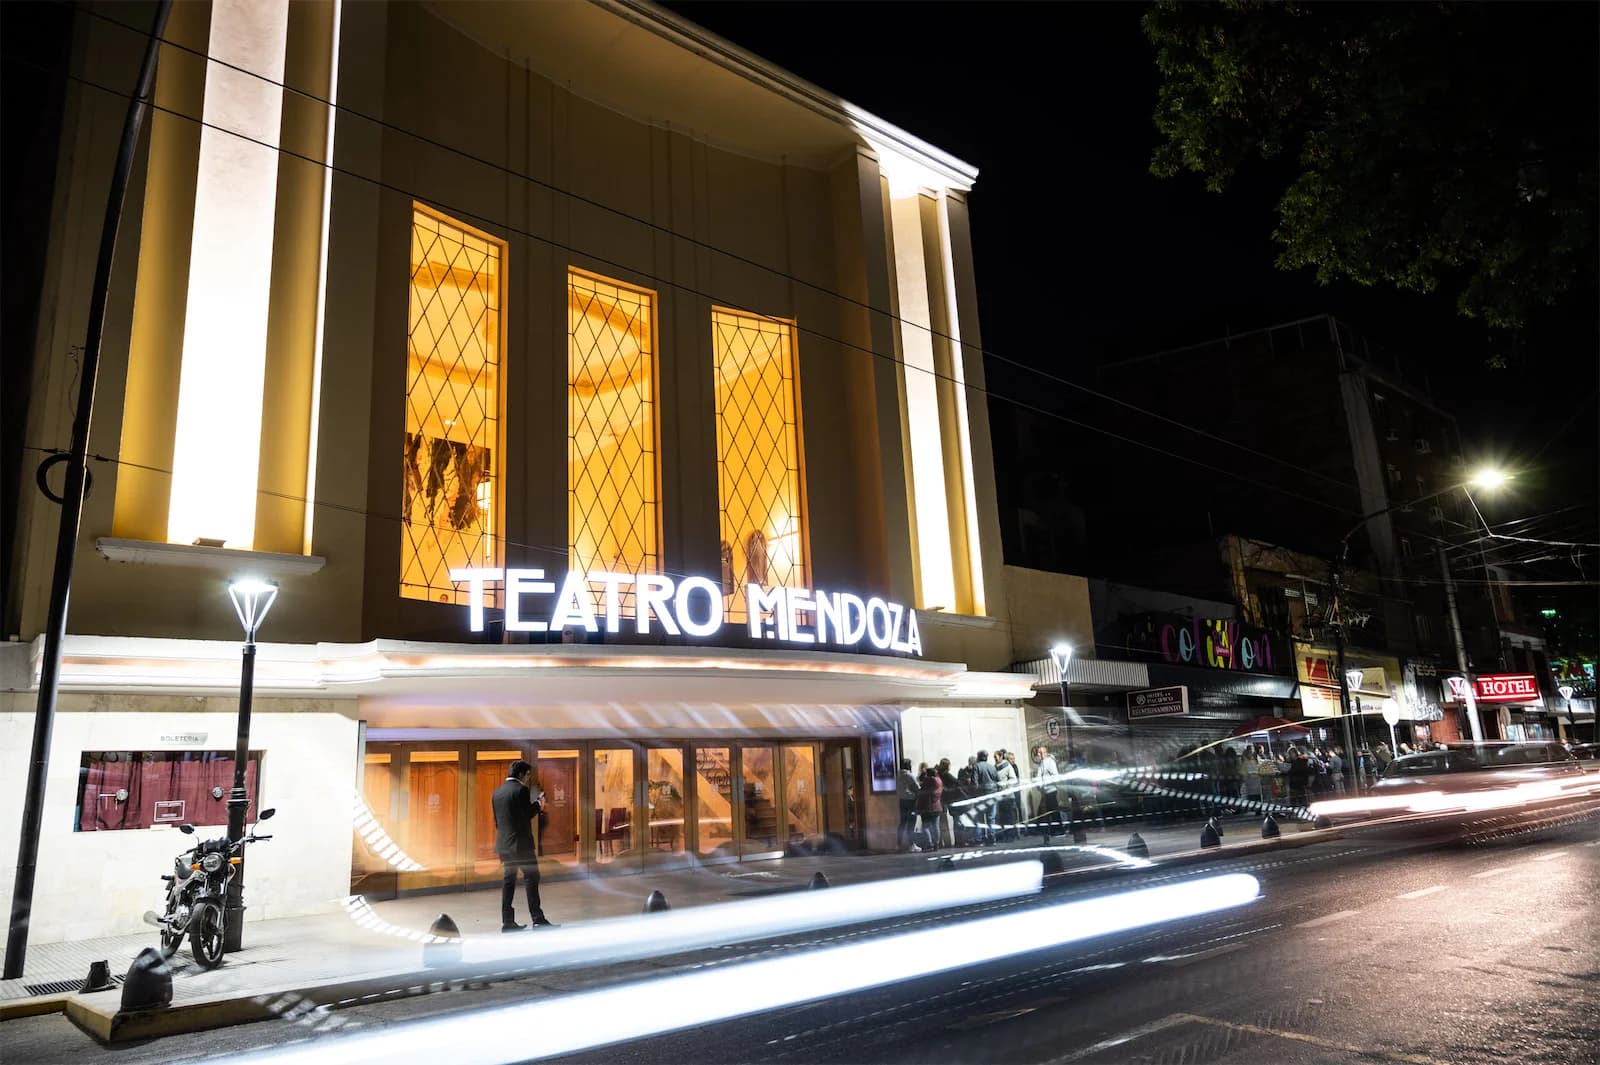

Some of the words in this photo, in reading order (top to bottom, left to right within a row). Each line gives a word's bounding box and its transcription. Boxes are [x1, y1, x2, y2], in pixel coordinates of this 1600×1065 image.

[449, 567, 723, 637] TEATRO
[746, 582, 923, 658] MENDOZA
[1482, 679, 1535, 695] HOTEL
